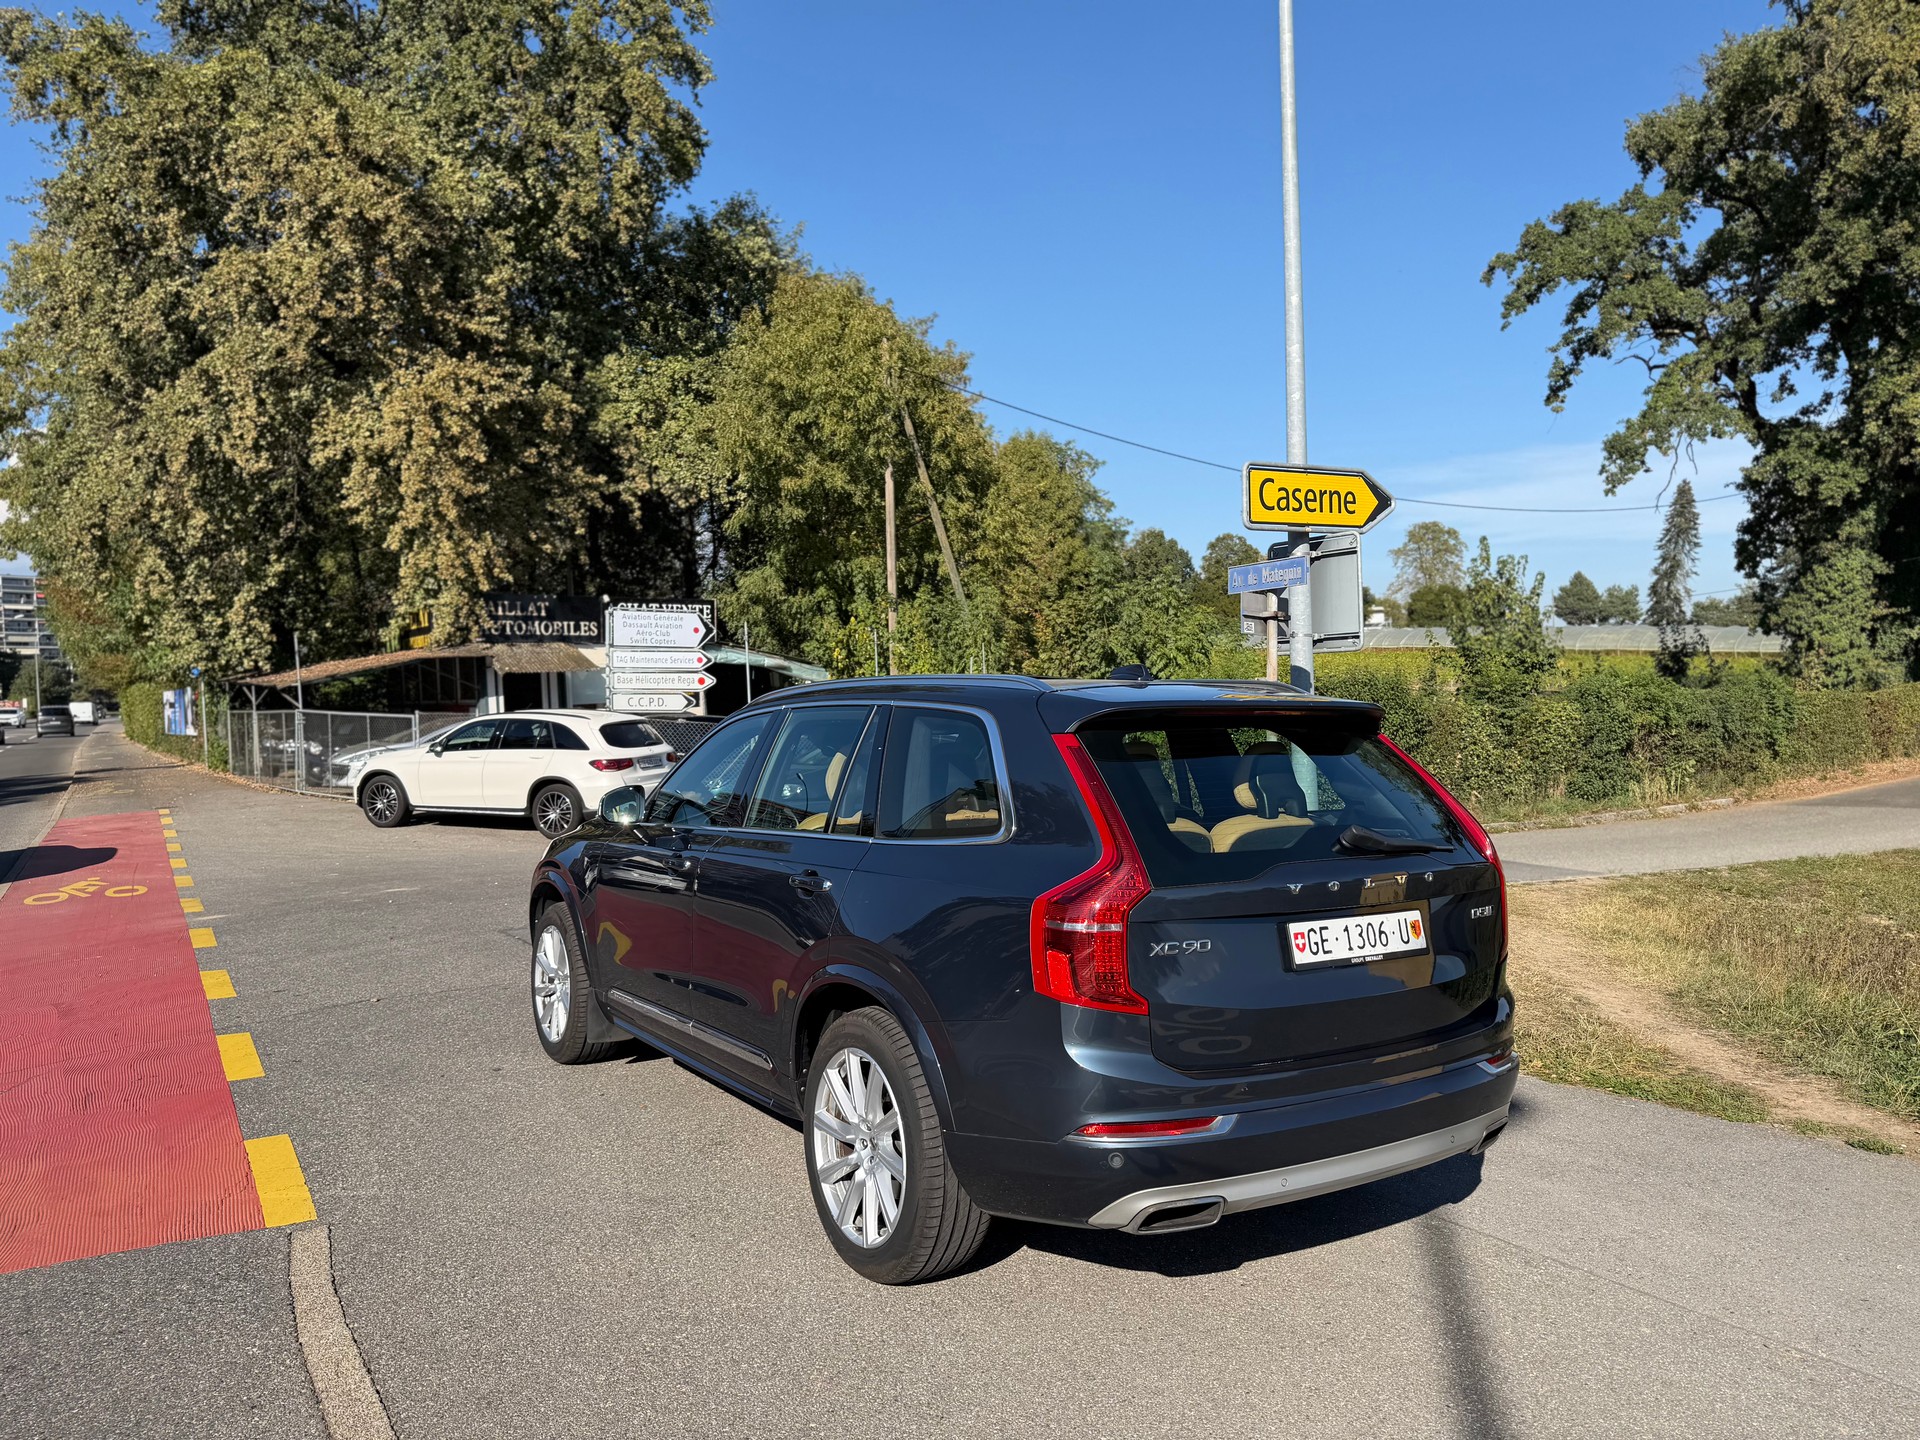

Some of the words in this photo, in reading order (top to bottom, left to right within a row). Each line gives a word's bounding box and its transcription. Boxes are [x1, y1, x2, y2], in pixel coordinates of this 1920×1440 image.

[1258, 477, 1357, 515] Caserne
[1232, 571, 1246, 588] Av.
[1247, 568, 1258, 587] de
[622, 613, 652, 621] Aviation
[653, 613, 684, 622] Générale
[654, 621, 683, 629] Aviation
[636, 629, 671, 637] Aéro-Club
[650, 638, 677, 646] Copters
[616, 655, 628, 664] TAG
[629, 655, 669, 664] Maintenance
[669, 656, 695, 664] Services
[616, 675, 633, 684] Base
[635, 675, 675, 686] Hélicoptère
[677, 676, 695, 686] Rega
[627, 697, 668, 707] C.C.P.D.
[1286, 871, 1434, 895] VOLVO
